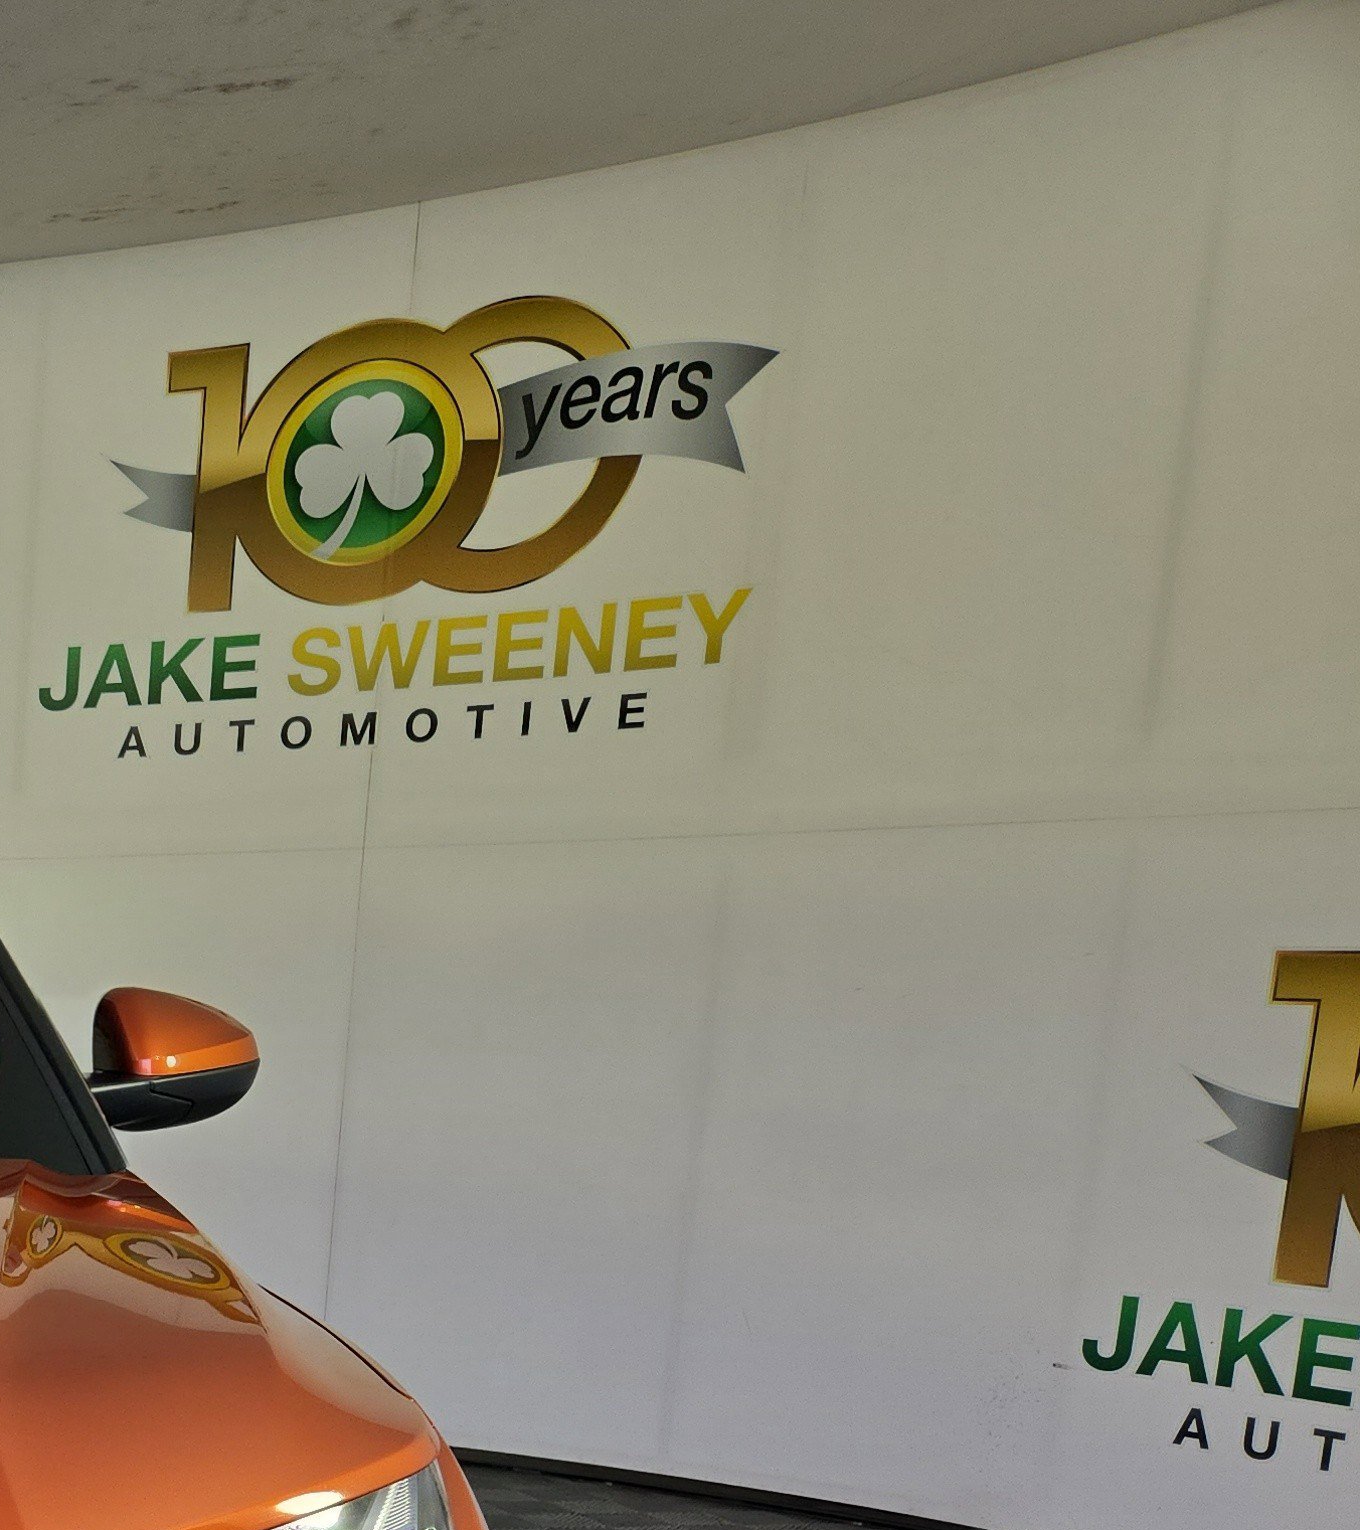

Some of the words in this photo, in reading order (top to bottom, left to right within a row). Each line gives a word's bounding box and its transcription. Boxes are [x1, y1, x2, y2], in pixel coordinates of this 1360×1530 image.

[167, 295, 643, 612] 100
[516, 360, 713, 460] years
[38, 634, 261, 711] JAKE
[288, 588, 752, 696] SWEENEY
[117, 693, 649, 759] AUTOMOTIVE
[1082, 1295, 1360, 1407] JAKE
